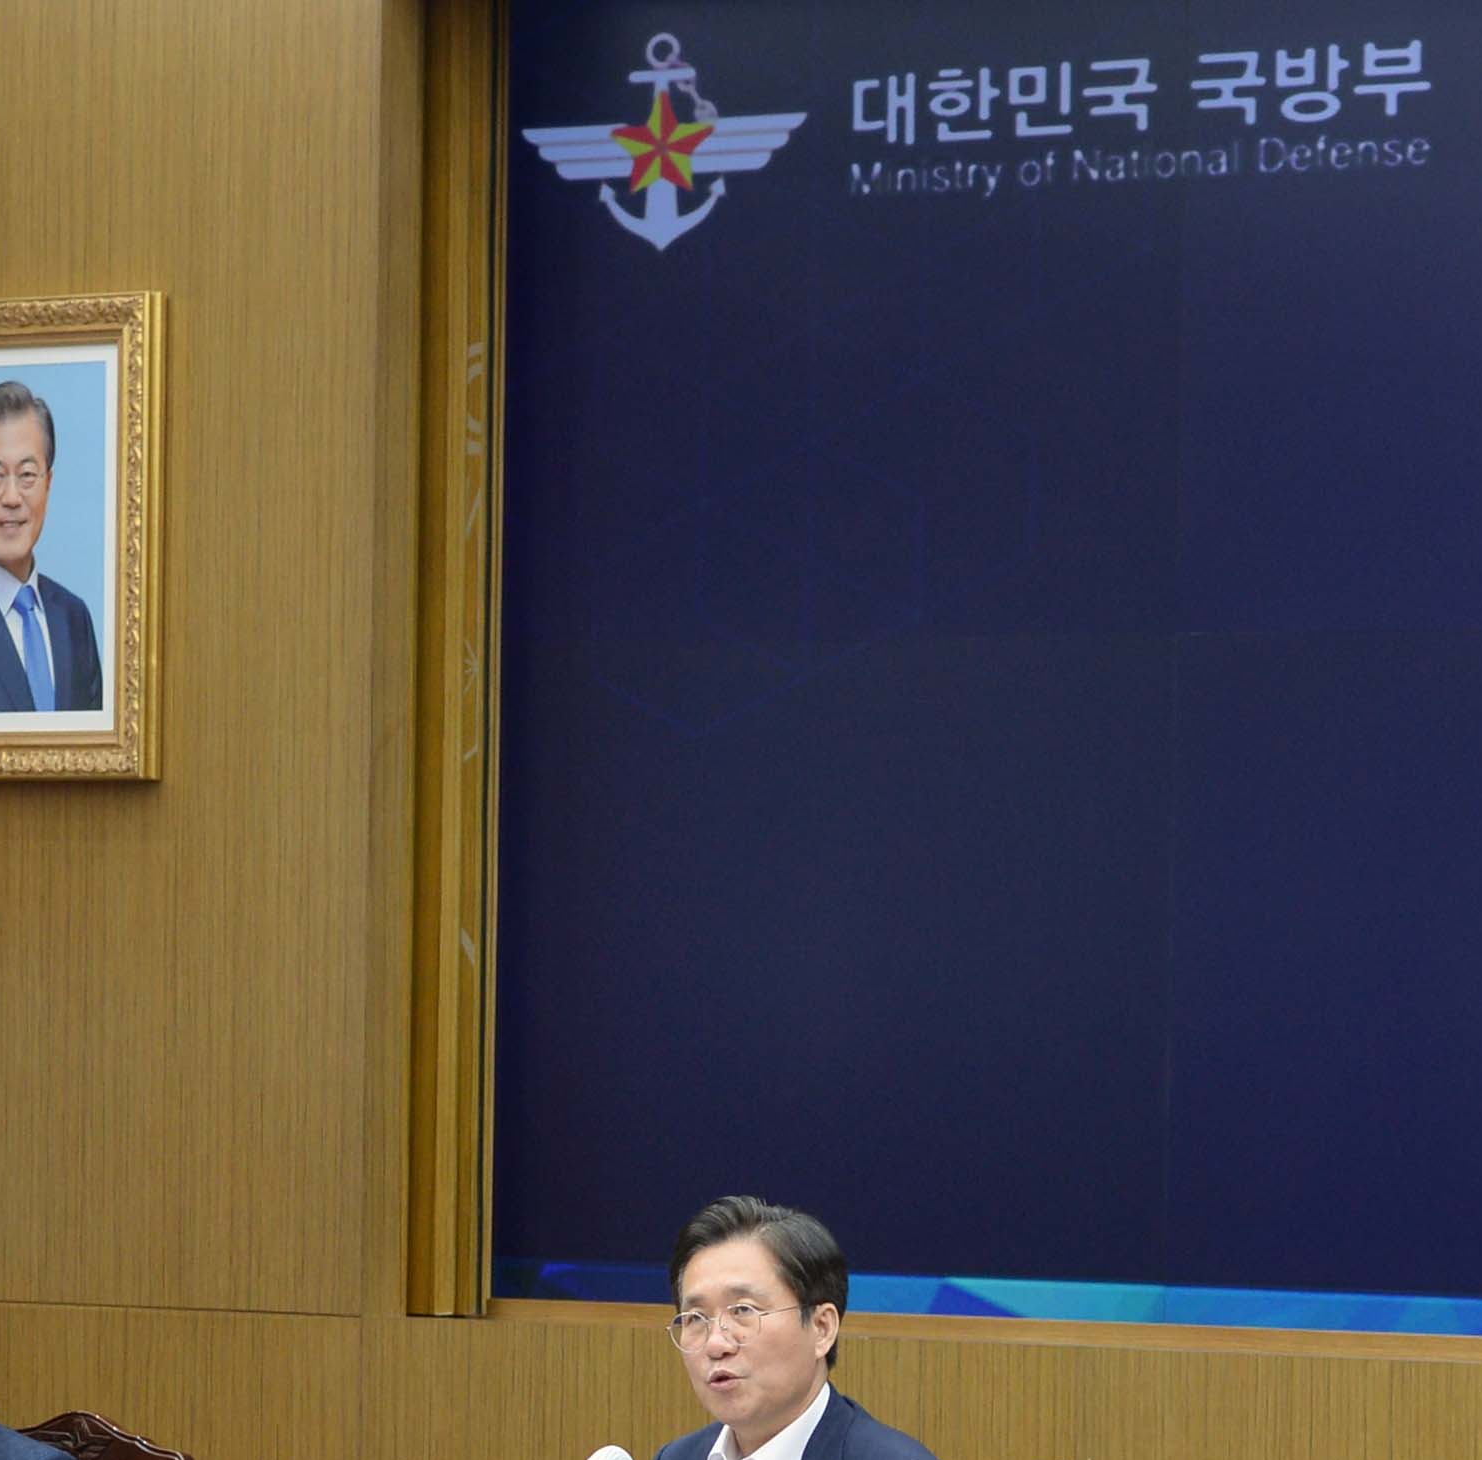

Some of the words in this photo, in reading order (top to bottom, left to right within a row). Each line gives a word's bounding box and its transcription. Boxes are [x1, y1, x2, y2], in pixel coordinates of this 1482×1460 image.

[853, 58, 1158, 145] 대한민국
[1190, 39, 1432, 125] 국방부
[850, 160, 1003, 197] Ministry
[1020, 150, 1055, 187] of
[1071, 140, 1239, 183] National
[1258, 134, 1431, 173] Defense
